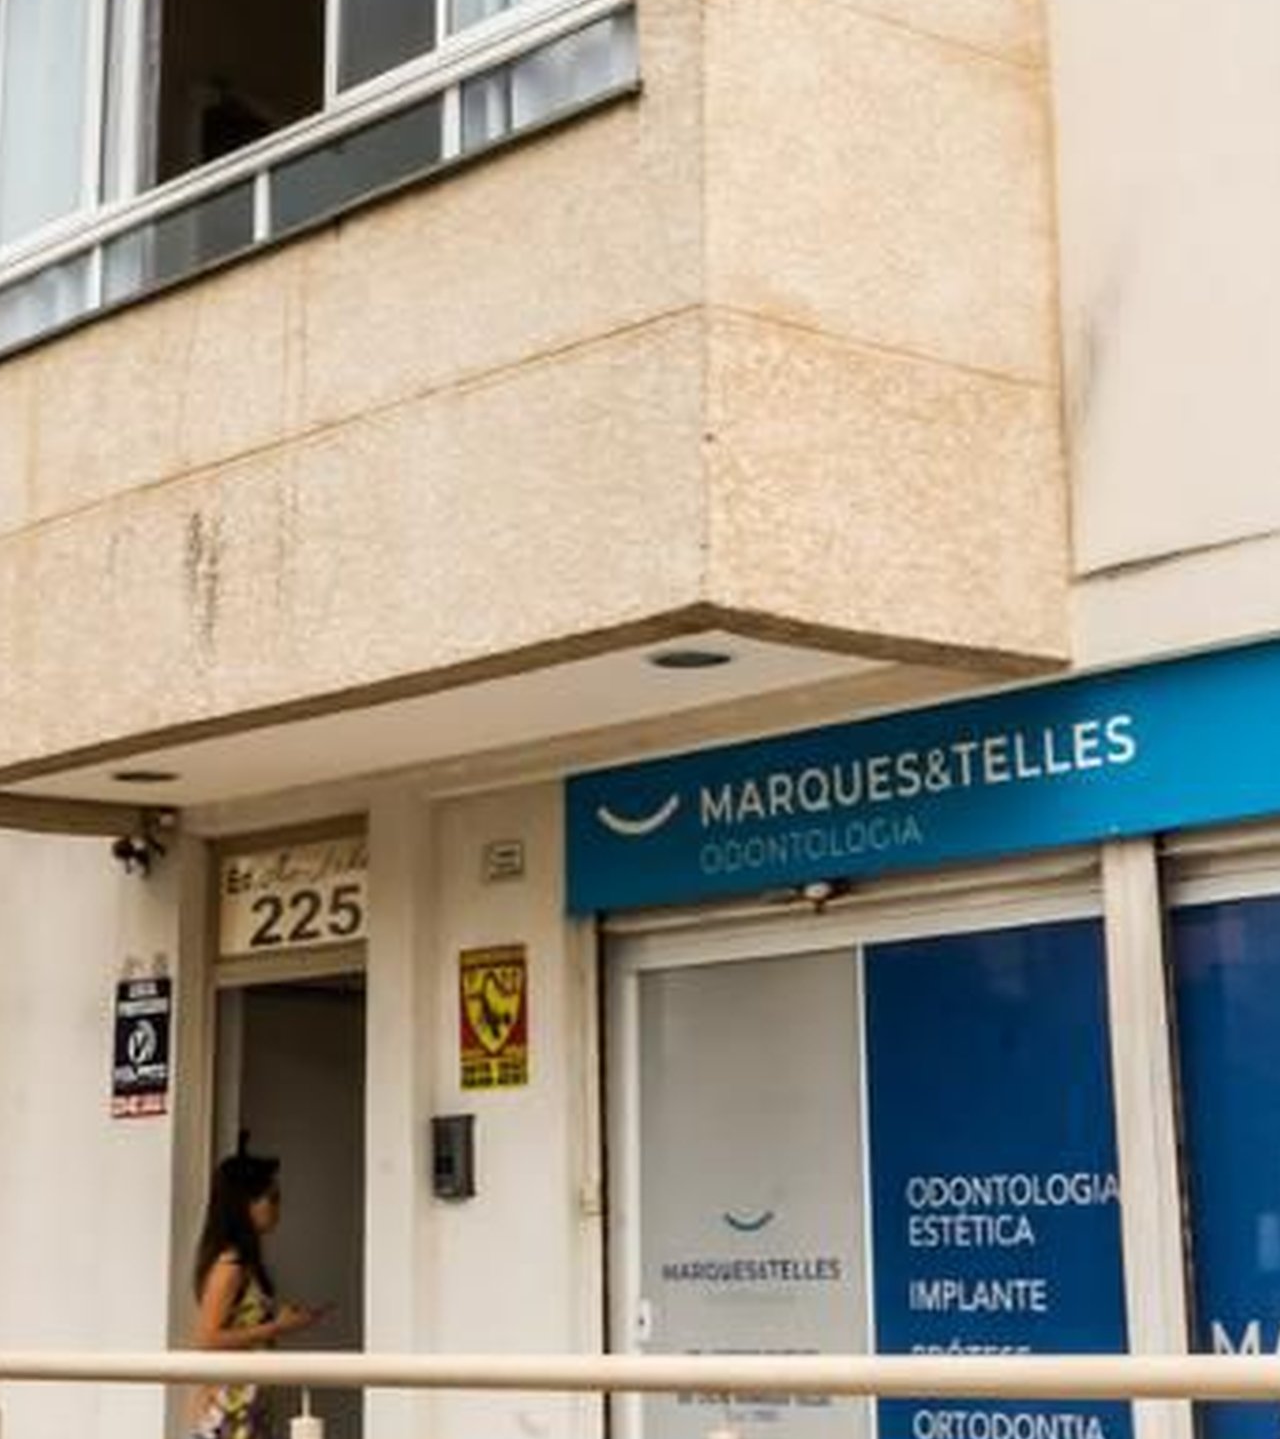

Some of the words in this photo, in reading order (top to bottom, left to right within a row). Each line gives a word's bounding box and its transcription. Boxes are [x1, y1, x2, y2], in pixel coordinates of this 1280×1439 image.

[700, 714, 1136, 827] MARQUES&TELLES
[700, 815, 924, 876] ODONTOLOGIA
[250, 885, 362, 947] 225
[907, 1173, 1120, 1210] ODONTOLOGIA
[908, 1211, 1036, 1248] ESTÉTICA
[909, 1279, 1048, 1312] IMPLANTE
